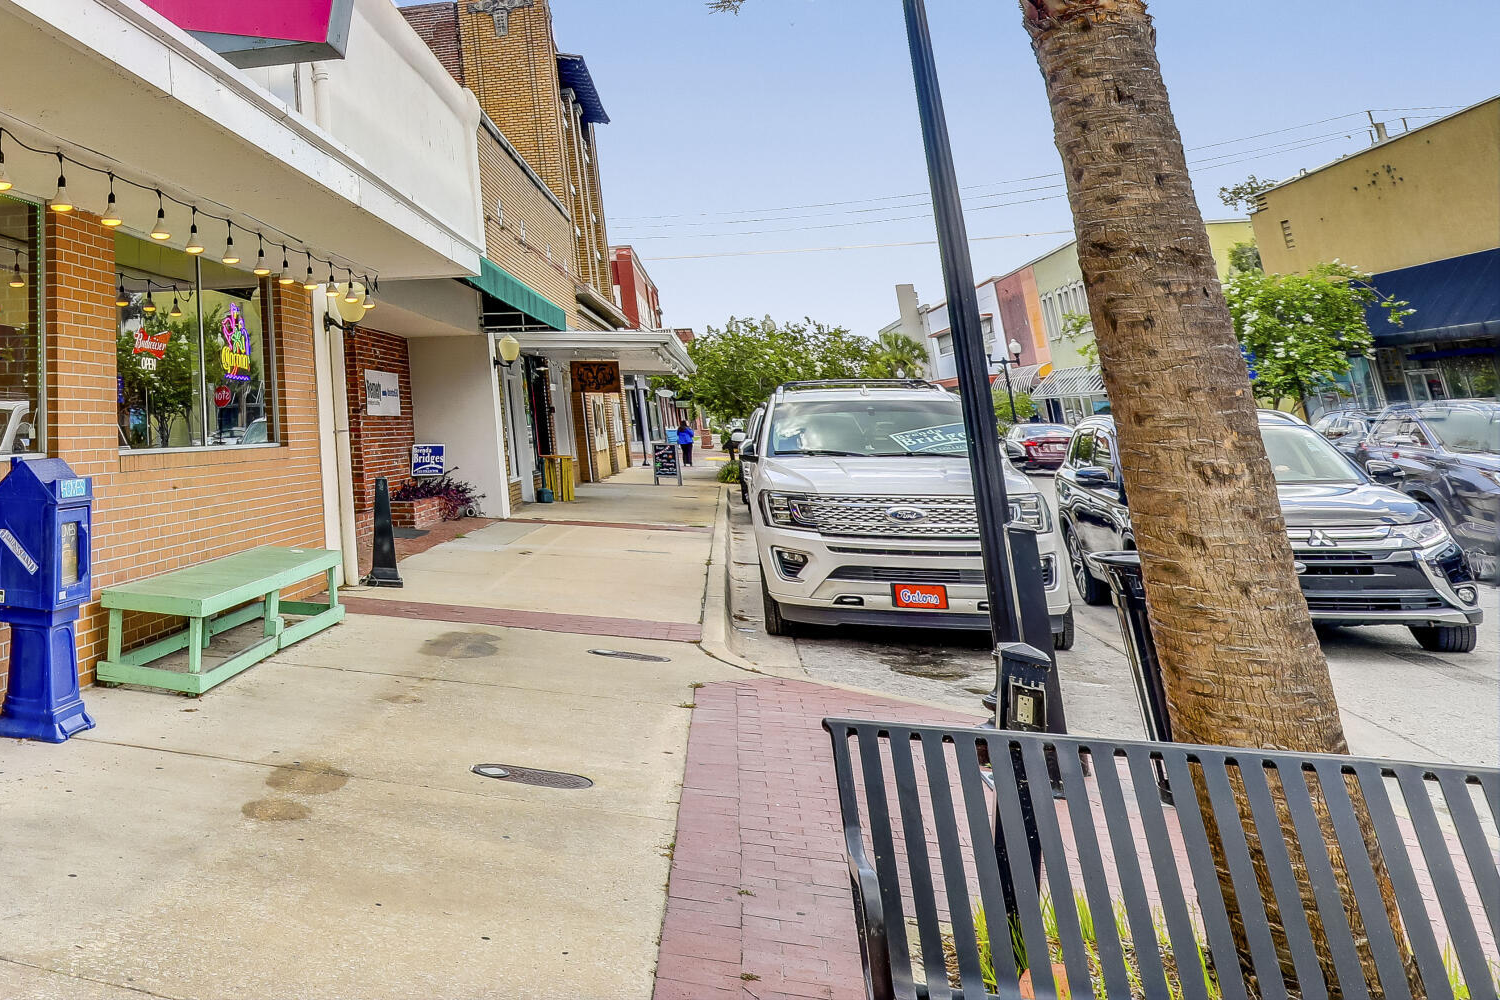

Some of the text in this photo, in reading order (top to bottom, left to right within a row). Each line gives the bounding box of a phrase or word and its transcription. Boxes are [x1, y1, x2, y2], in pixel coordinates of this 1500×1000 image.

[133, 332, 167, 352] Budweiser
[141, 357, 157, 370] OPEN
[221, 346, 250, 374] Corona
[902, 430, 966, 446] Bridge
[413, 453, 444, 465] Bridges
[61, 479, 86, 498] HOMES
[896, 511, 917, 519] Ford
[62, 523, 76, 538] OMES
[900, 588, 940, 604] Gators
